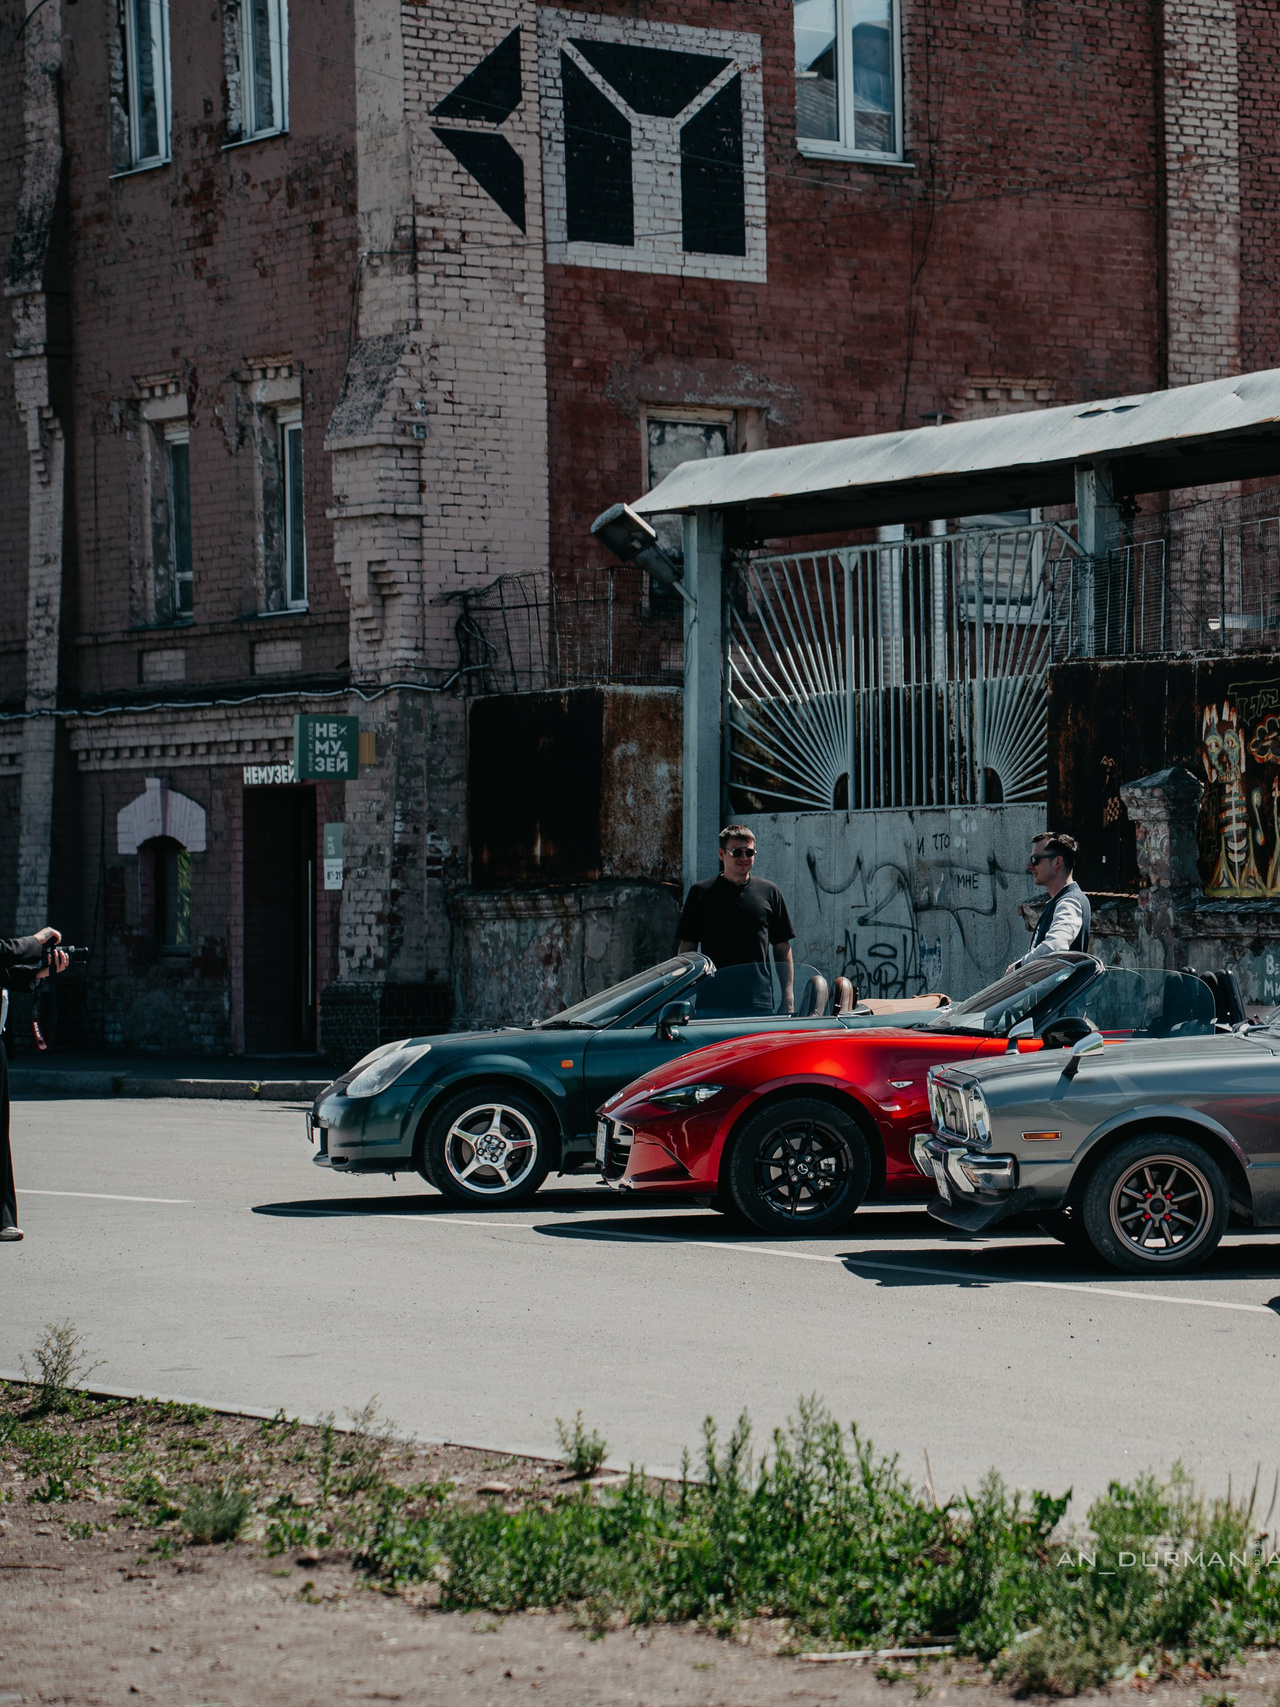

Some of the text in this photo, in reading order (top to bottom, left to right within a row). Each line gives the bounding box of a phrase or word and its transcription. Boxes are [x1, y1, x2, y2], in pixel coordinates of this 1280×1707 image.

[315, 722, 338, 738] НЕ
[315, 740, 342, 755] МУ
[243, 760, 297, 785] НЕМУЗЕЙ
[957, 873, 980, 890] МНЕ
